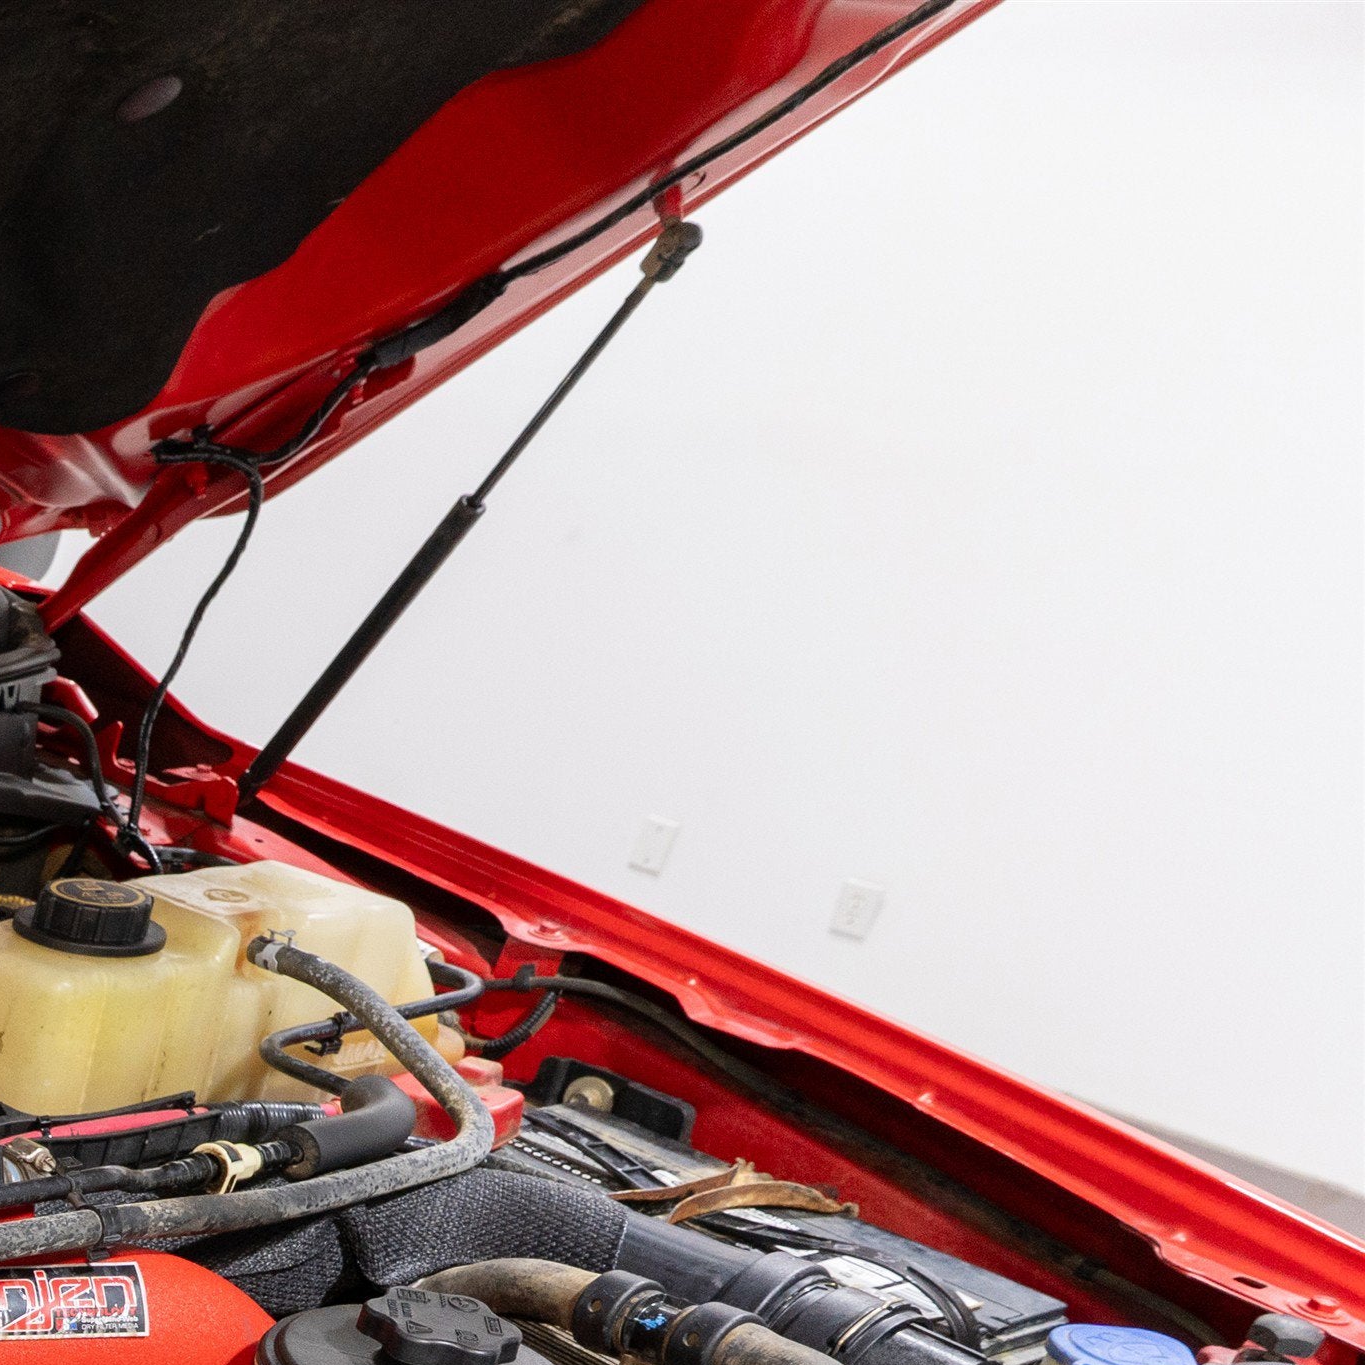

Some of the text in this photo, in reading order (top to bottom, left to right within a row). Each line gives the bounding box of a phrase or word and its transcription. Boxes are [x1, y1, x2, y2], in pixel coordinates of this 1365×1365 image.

[81, 1321, 139, 1331] DRY FILTER MEDIA
